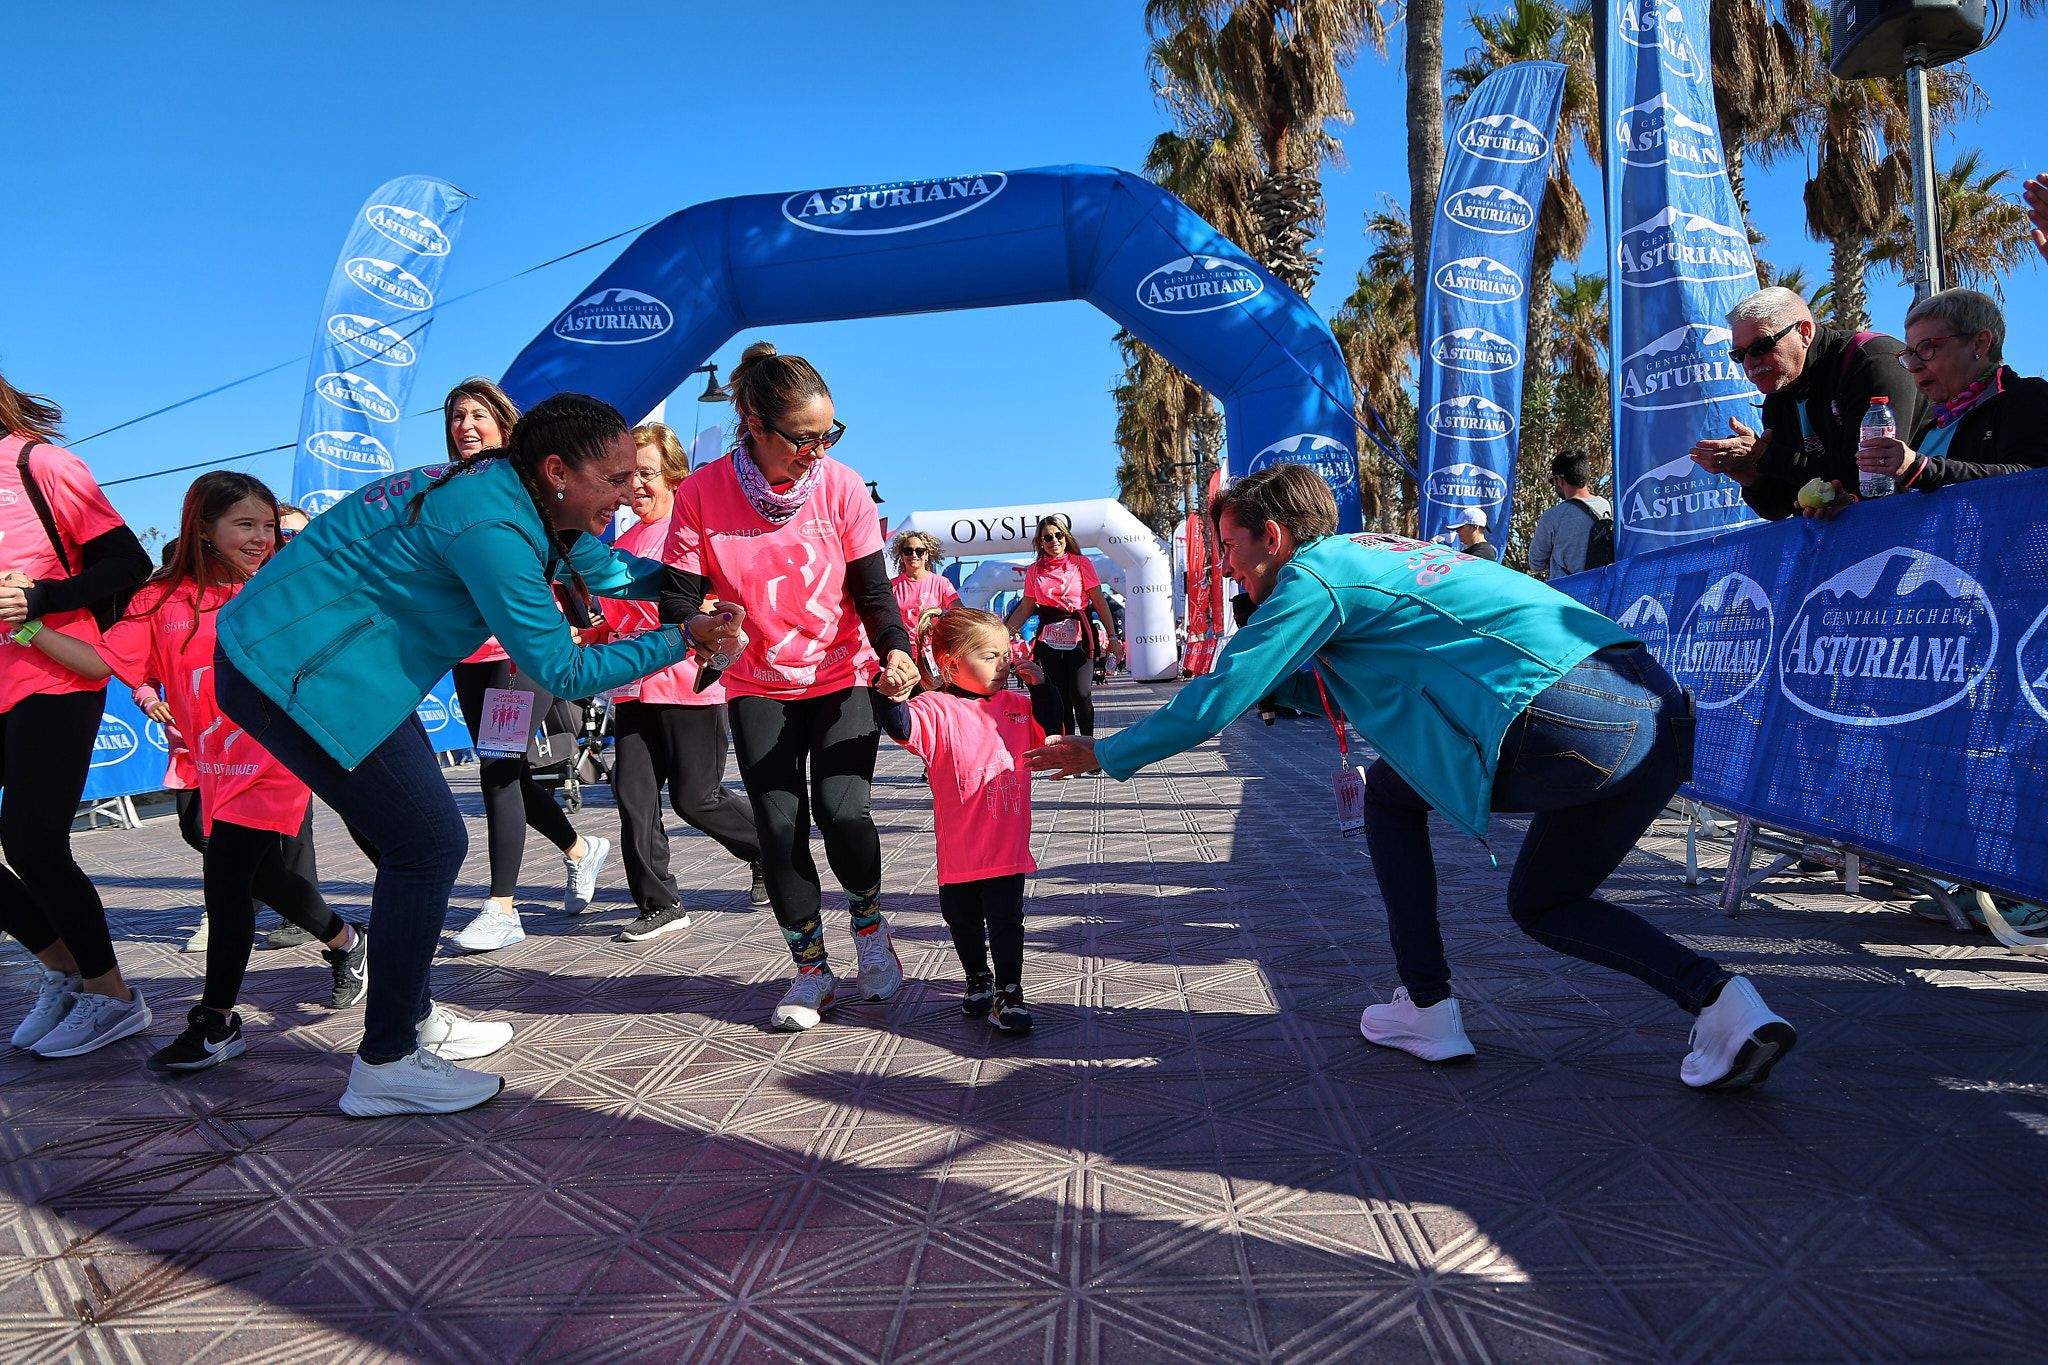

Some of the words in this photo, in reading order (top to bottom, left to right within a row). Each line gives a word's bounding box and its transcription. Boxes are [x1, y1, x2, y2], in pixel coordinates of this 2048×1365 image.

[1464, 127, 1541, 156] ASTURIANA
[797, 178, 991, 218] ASTURIANA
[1450, 198, 1526, 226] ASTURIANA
[1620, 242, 1754, 273] ASTURIANA
[351, 263, 425, 308] ASTURIANA
[1147, 278, 1258, 305] ASTURIANA
[1441, 269, 1517, 296] ASTURIANA
[559, 313, 664, 334] ASTURIANA
[1436, 341, 1514, 365] ASTURIANA
[1646, 351, 1704, 371] CENTRAL
[1621, 360, 1749, 399] ASTURIA
[1433, 409, 1507, 432] ASTURIANA
[312, 438, 392, 470] ASTURIANA
[1429, 478, 1502, 499] ASTURIANA
[1653, 477, 1713, 495] CENTRAL
[1108, 535, 1146, 544] OYSHO
[1132, 584, 1167, 594] OYSHO
[1822, 610, 1889, 626] CENTRAL
[1893, 607, 1973, 625] LECHERA
[1136, 634, 1170, 644] OYSHO
[1676, 626, 1762, 674] ASTURIANA
[1785, 614, 1967, 683] ASTURIANA
[820, 645, 850, 670] MUJER
